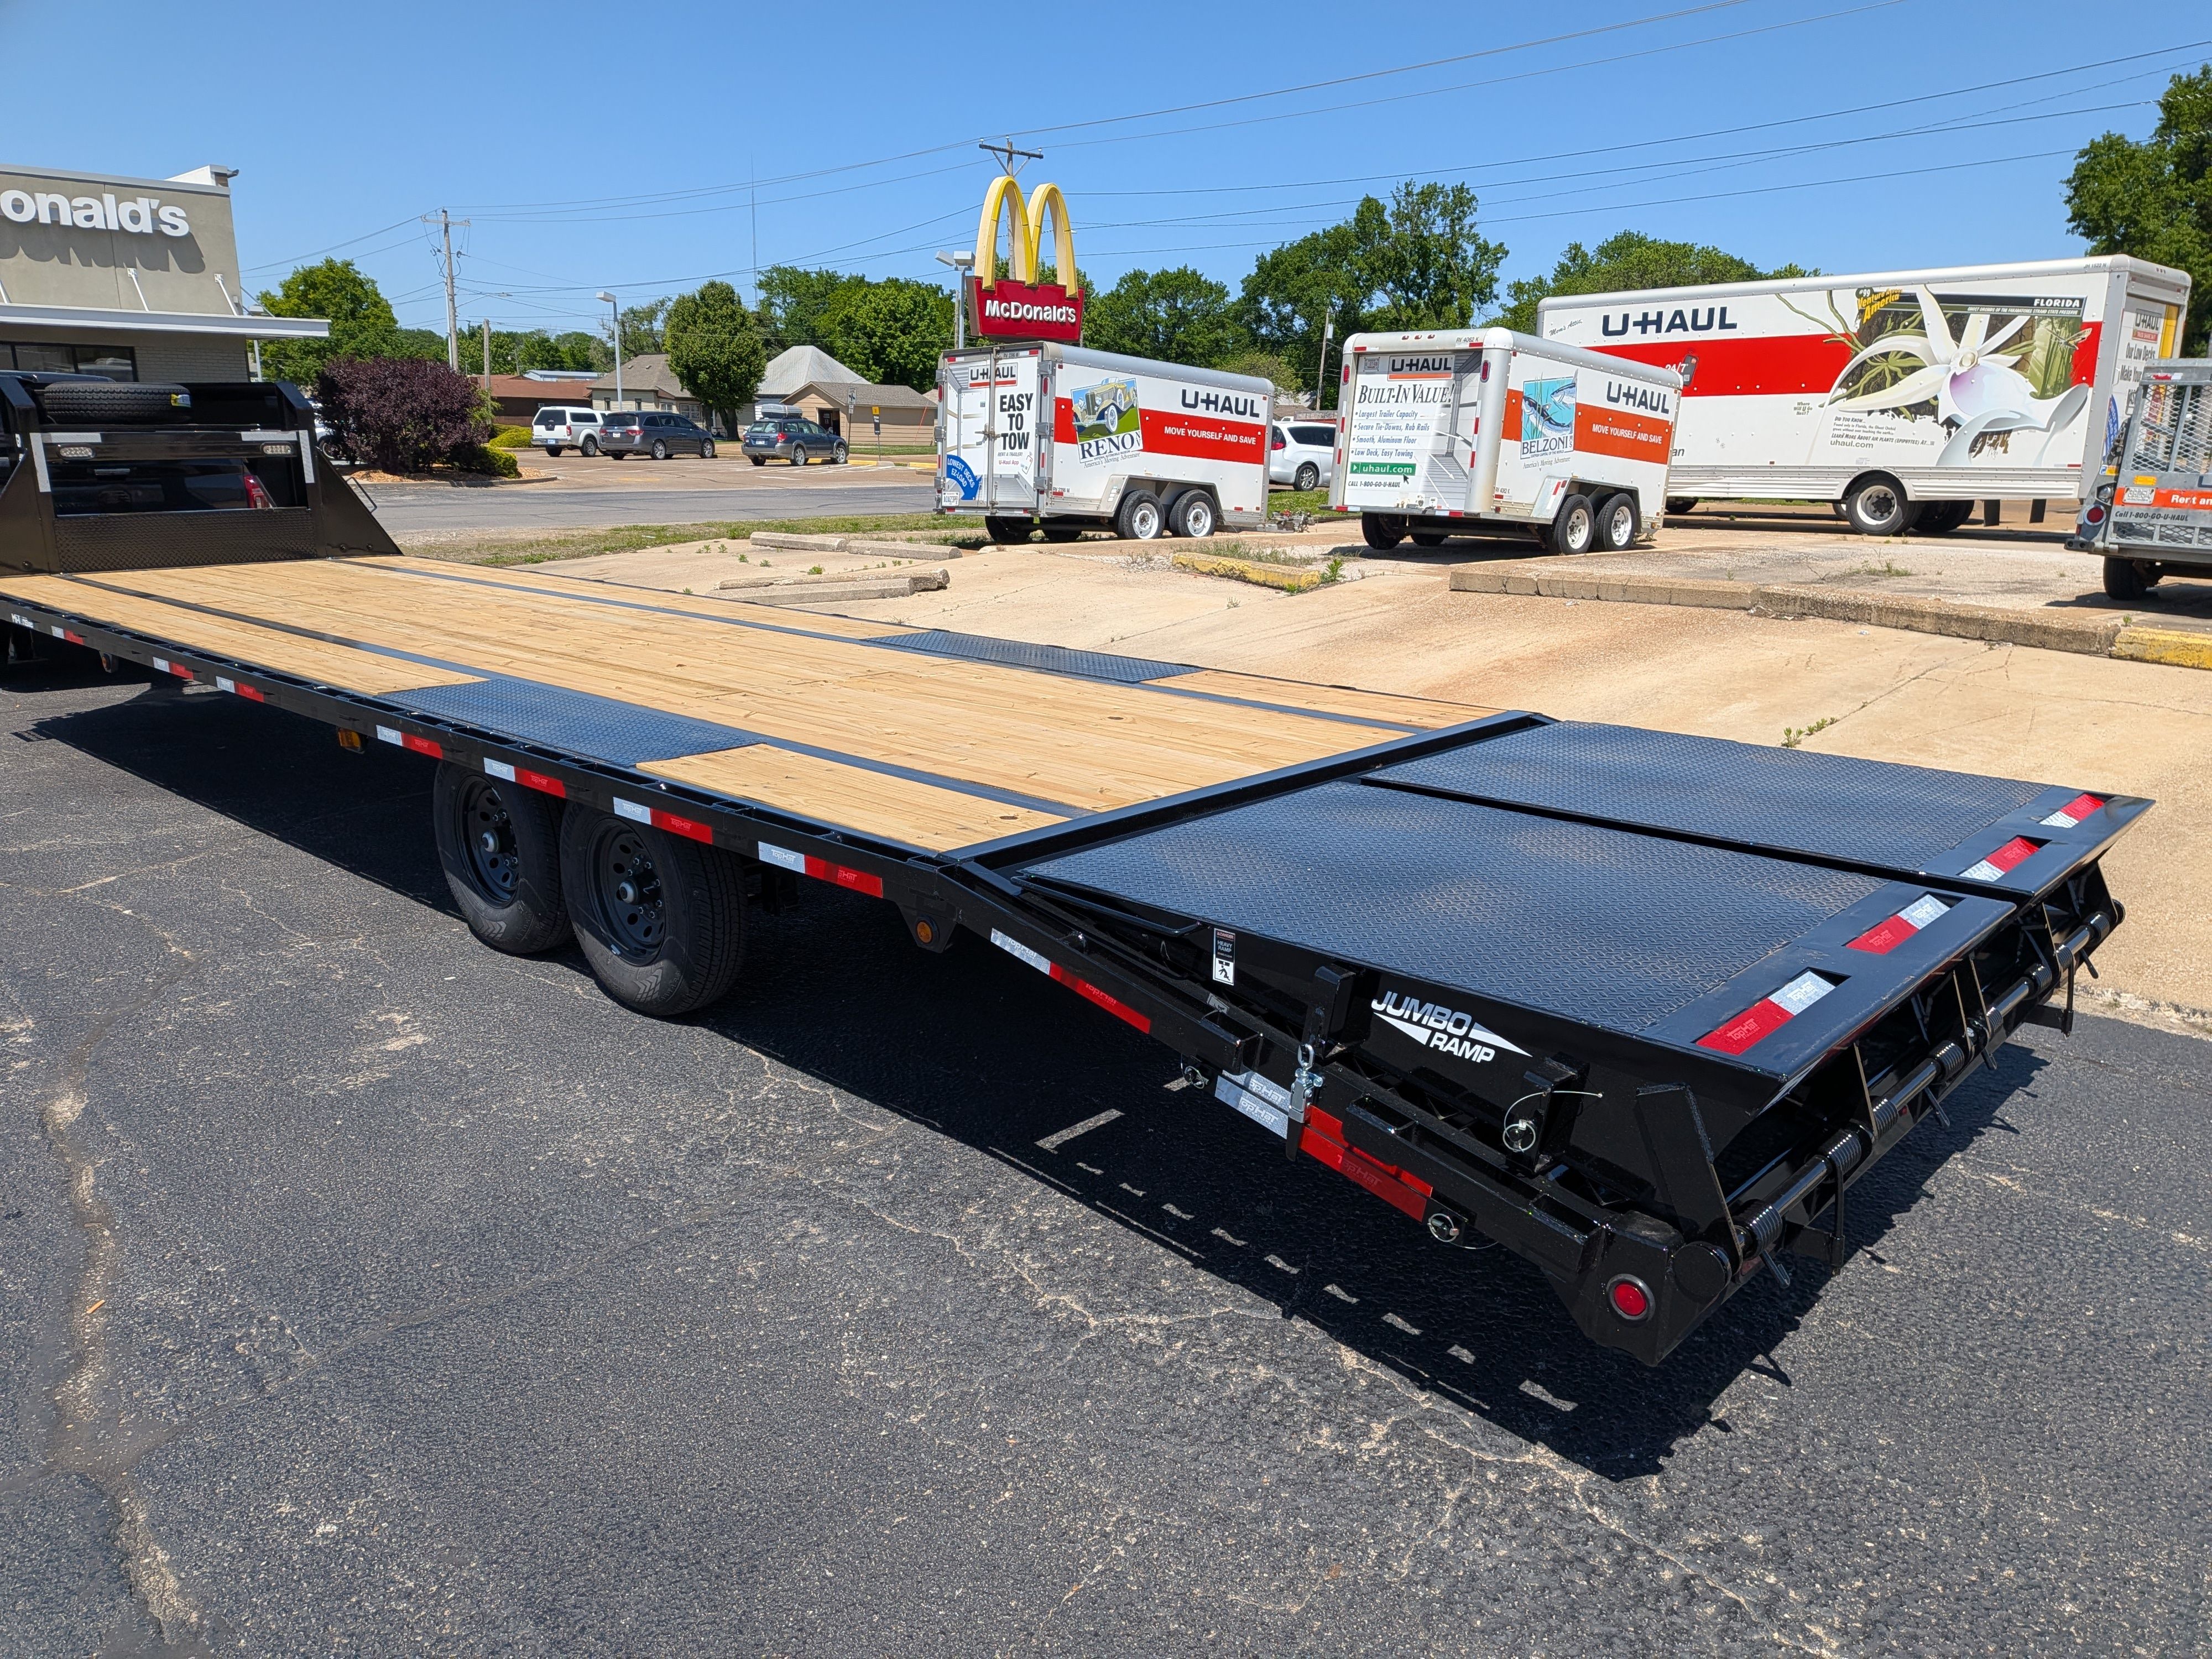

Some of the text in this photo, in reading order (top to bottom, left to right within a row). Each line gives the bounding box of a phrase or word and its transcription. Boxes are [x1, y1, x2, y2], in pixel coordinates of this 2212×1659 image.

[0, 190, 190, 237] onald's
[1858, 291, 1885, 310] Venture
[1859, 289, 1871, 298] #99
[2033, 298, 2080, 307] FLORIDA
[985, 299, 1076, 323] McDonald's
[1863, 294, 1900, 324] America
[1602, 306, 1738, 336] U-HAUL
[2135, 312, 2159, 331] U-HAUL
[2126, 342, 2134, 359] Our
[2133, 343, 2142, 360] Low
[971, 366, 1015, 380] U-HAUL
[1391, 358, 1452, 372] U-HAUL
[2120, 364, 2132, 382] Make
[1000, 393, 1034, 412] EASY
[1358, 383, 1455, 404] BUILT-IN VALUE!
[1606, 381, 1670, 414] U-HAUL
[1181, 389, 1260, 418] U-HAUL
[1008, 413, 1024, 431] TO
[1359, 410, 1377, 419] Largest
[1396, 410, 1418, 420] Capacity
[1164, 426, 1256, 445] MOVE YOURSELF AND SAVE
[1375, 422, 1403, 431] Tie-Downs,
[1592, 424, 1662, 444] MOVE YOURSELF AND SAVE
[1001, 432, 1030, 450] TOW
[1080, 433, 1134, 460] RENO
[1356, 435, 1375, 444] Smooth,
[1522, 436, 1568, 455] BELZONI
[1830, 440, 1874, 448] uhaul.com
[947, 458, 964, 471] LOWEST
[1394, 451, 1413, 459] Towing
[951, 468, 968, 487] EZ-LOAD
[1363, 464, 1412, 473] uhaul.com
[963, 469, 975, 488] DECKS
[2130, 512, 2188, 521] 1-800-GO-U-HAUL
[1217, 940, 1233, 948] HEAVY
[1371, 991, 1472, 1036] JUMBO
[1430, 1032, 1495, 1063] RAMP
